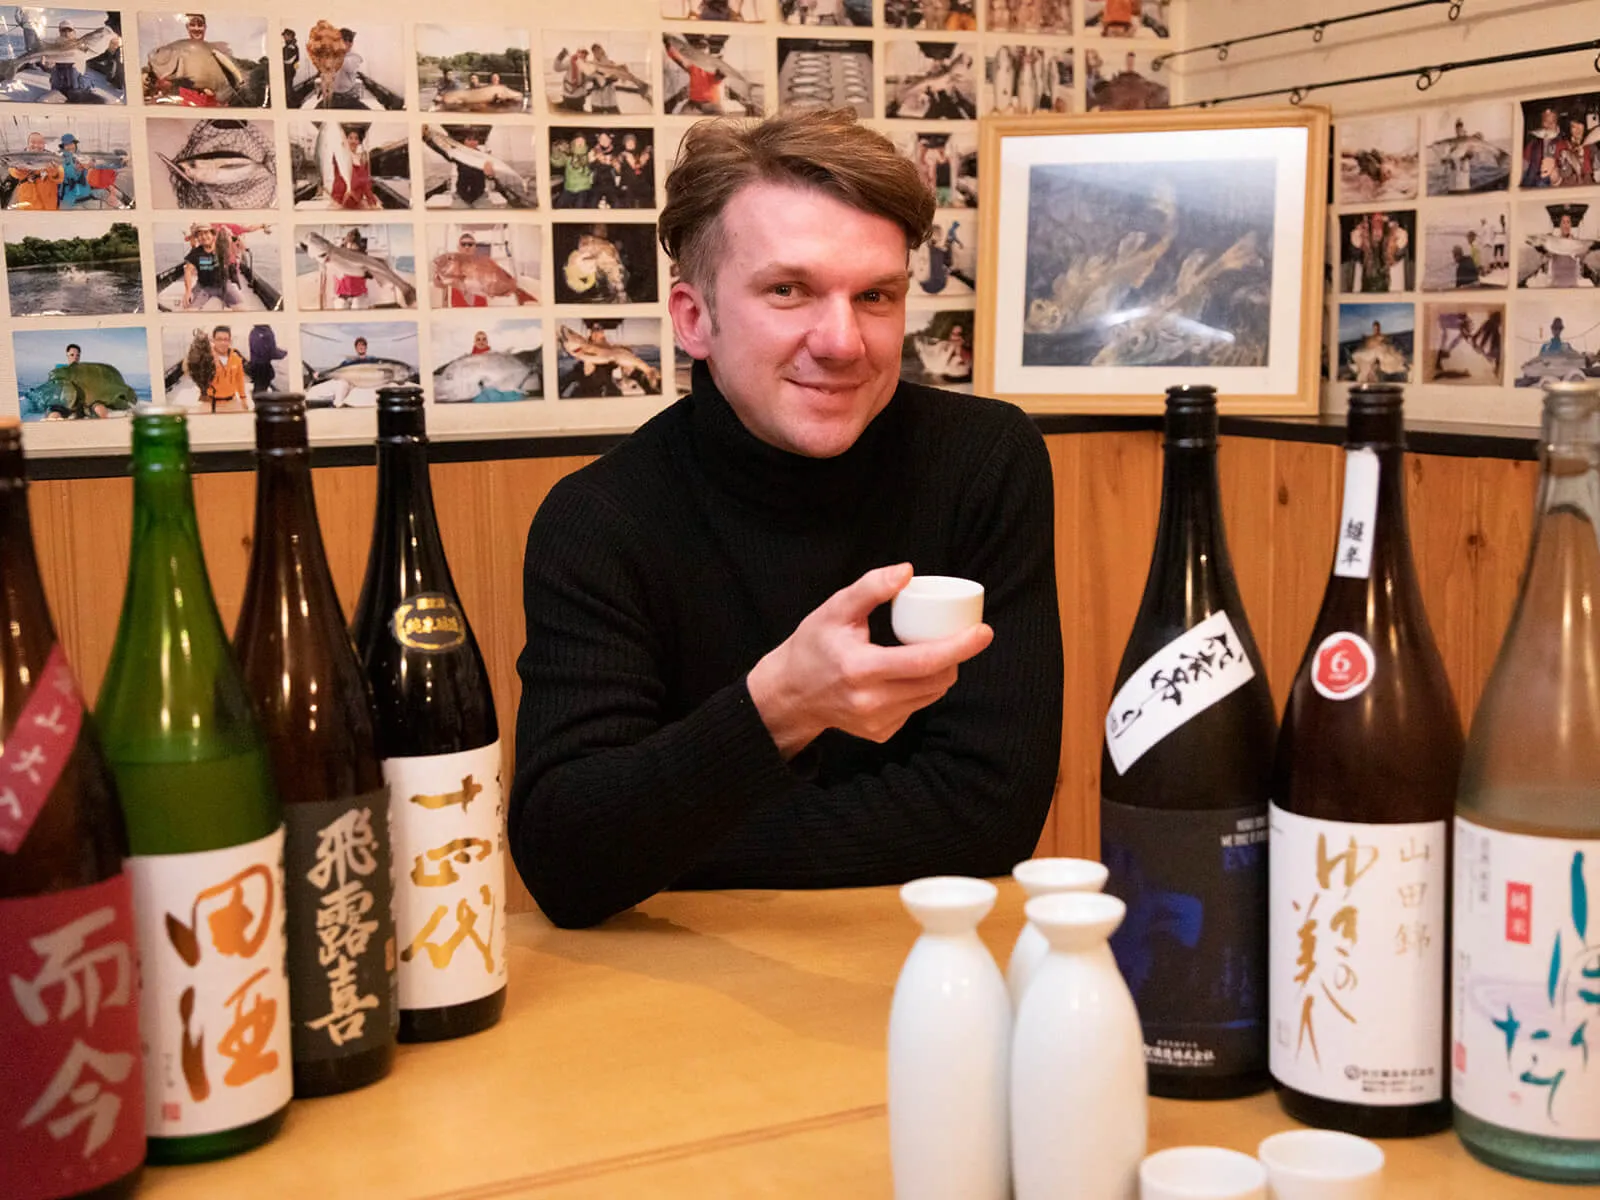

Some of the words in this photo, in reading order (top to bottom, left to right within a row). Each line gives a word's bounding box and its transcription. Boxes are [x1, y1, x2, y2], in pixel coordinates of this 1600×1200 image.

[1330, 650, 1352, 674] 6
[165, 863, 279, 1103] 田酒
[307, 808, 380, 1047] 飛露喜
[402, 773, 494, 975] 十四代
[9, 907, 132, 1159] 而今
